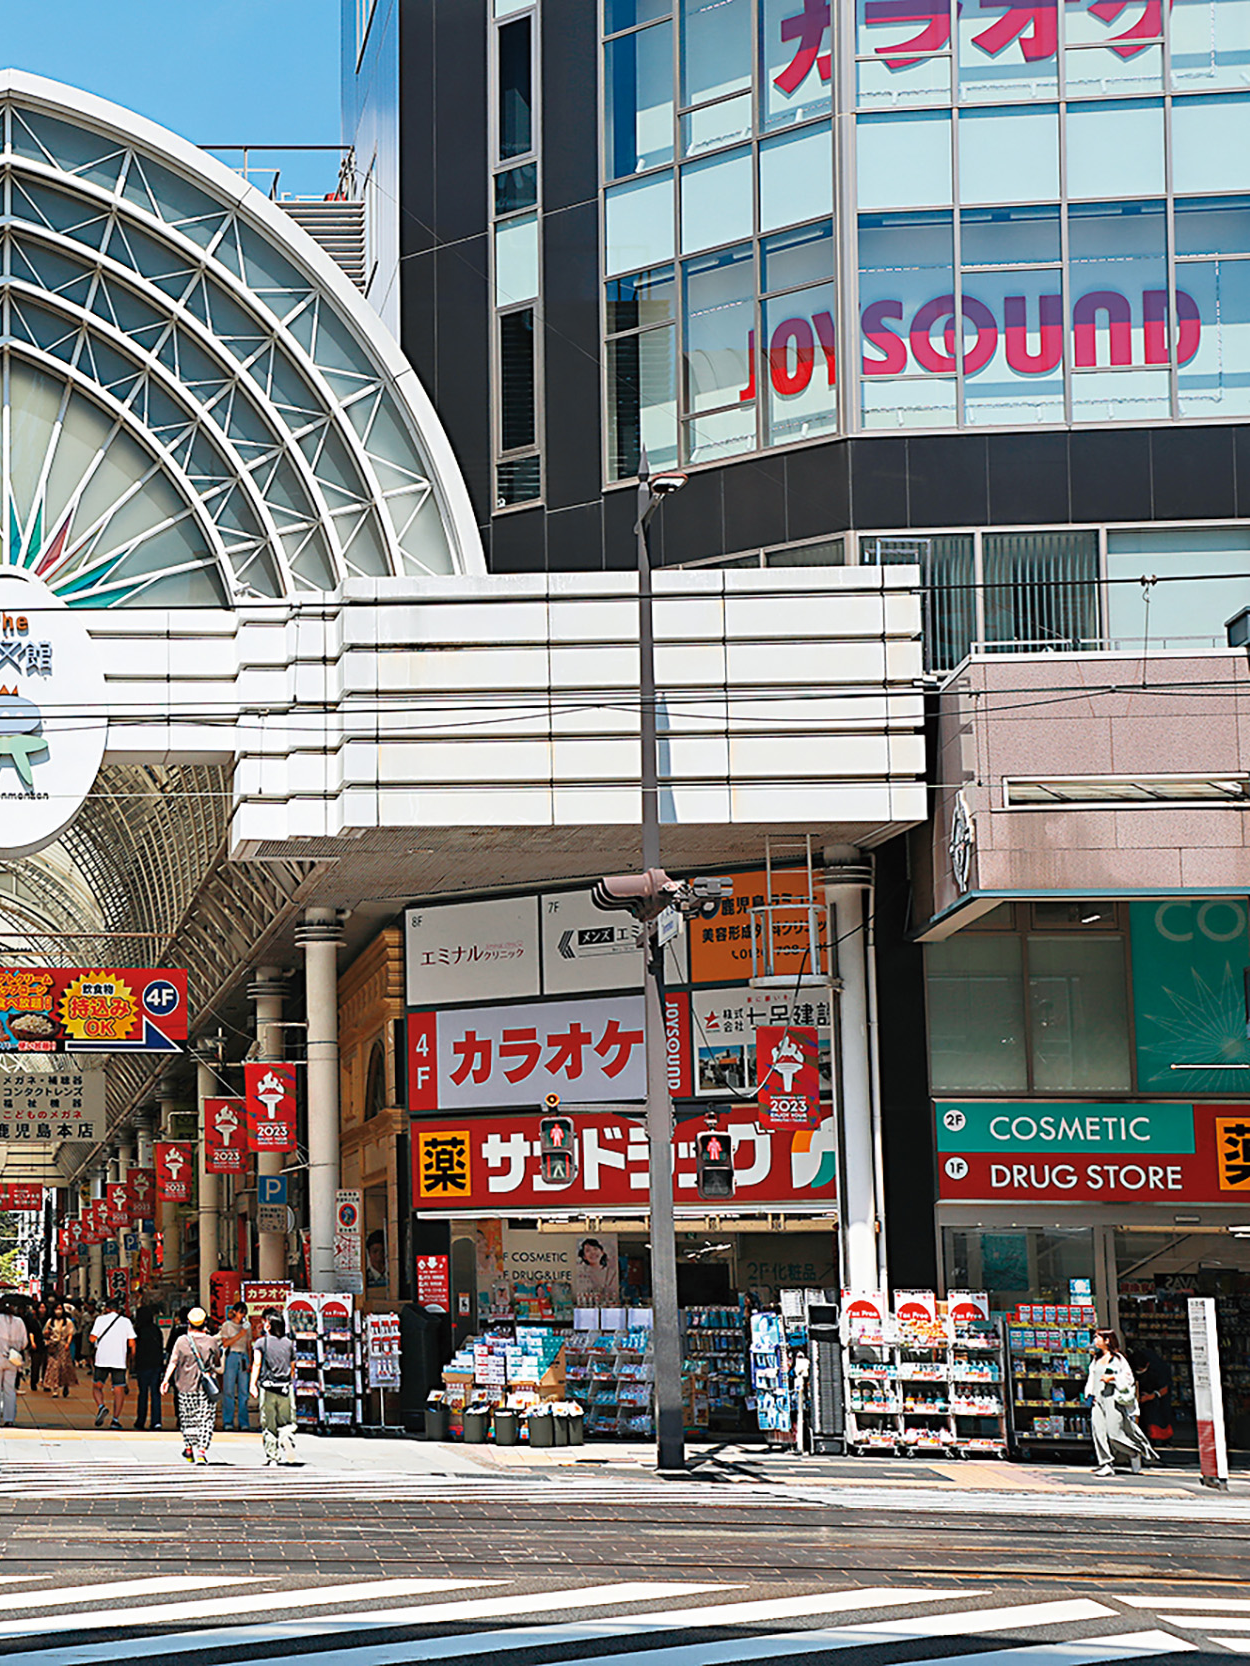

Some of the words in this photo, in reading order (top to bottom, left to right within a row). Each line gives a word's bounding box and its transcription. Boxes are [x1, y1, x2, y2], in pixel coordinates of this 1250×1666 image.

[739, 290, 1201, 402] JOYSOUND
[548, 901, 559, 913] 7F
[582, 928, 612, 943] メンズ
[82, 983, 114, 996] 飲食物
[146, 986, 174, 1006] 4F
[70, 996, 131, 1019] 持込み
[84, 1020, 116, 1038] OK
[724, 1021, 745, 1033] 会社
[665, 1001, 681, 1091] JOYSOUND
[450, 1020, 645, 1087] カラオケ
[2, 1087, 83, 1097] コンタクトレンズ
[769, 1100, 808, 1112] 2023
[2, 1109, 83, 1120] こどものメガネ
[947, 1114, 963, 1126] 2F
[257, 1126, 289, 1137] 2023
[989, 1117, 1151, 1141] COSMETIC
[213, 1153, 241, 1162] 2023
[423, 1137, 468, 1192] 薬
[949, 1162, 964, 1174] 1F
[990, 1165, 1078, 1189] DRUG
[1086, 1164, 1183, 1190] STORE
[165, 1183, 187, 1192] 2023
[266, 1179, 282, 1201] P
[126, 1237, 136, 1251] P
[511, 1252, 569, 1263] COSMETIC
[512, 1271, 573, 1281] DRUG&LIFE
[248, 1288, 288, 1300] カラオケ
[914, 1311, 929, 1319] Free
[968, 1311, 982, 1319] Free
